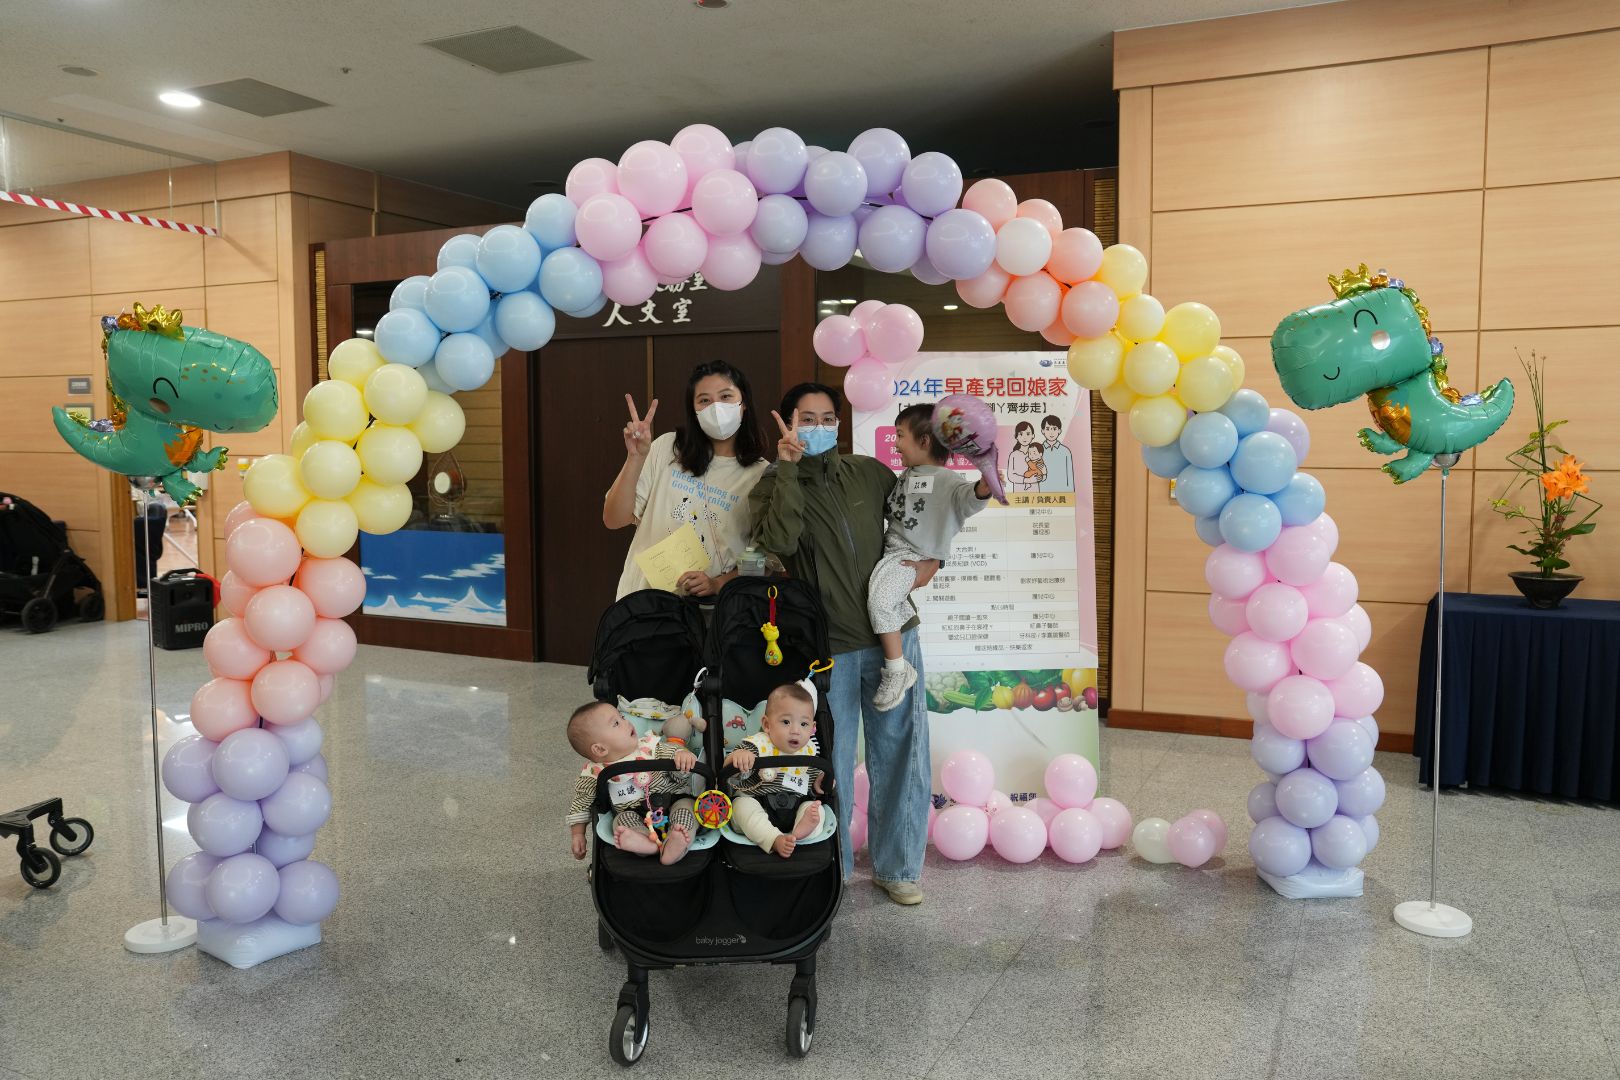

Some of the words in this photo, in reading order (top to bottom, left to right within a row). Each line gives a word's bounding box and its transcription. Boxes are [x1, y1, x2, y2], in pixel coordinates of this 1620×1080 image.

[602, 298, 693, 327] 人文室
[671, 479, 696, 495] Good
[1014, 496, 1030, 504] 主講
[1036, 496, 1067, 504] 負責人員
[175, 621, 209, 631] MIPRO
[695, 936, 713, 946] baby
[714, 936, 739, 946] jogger
